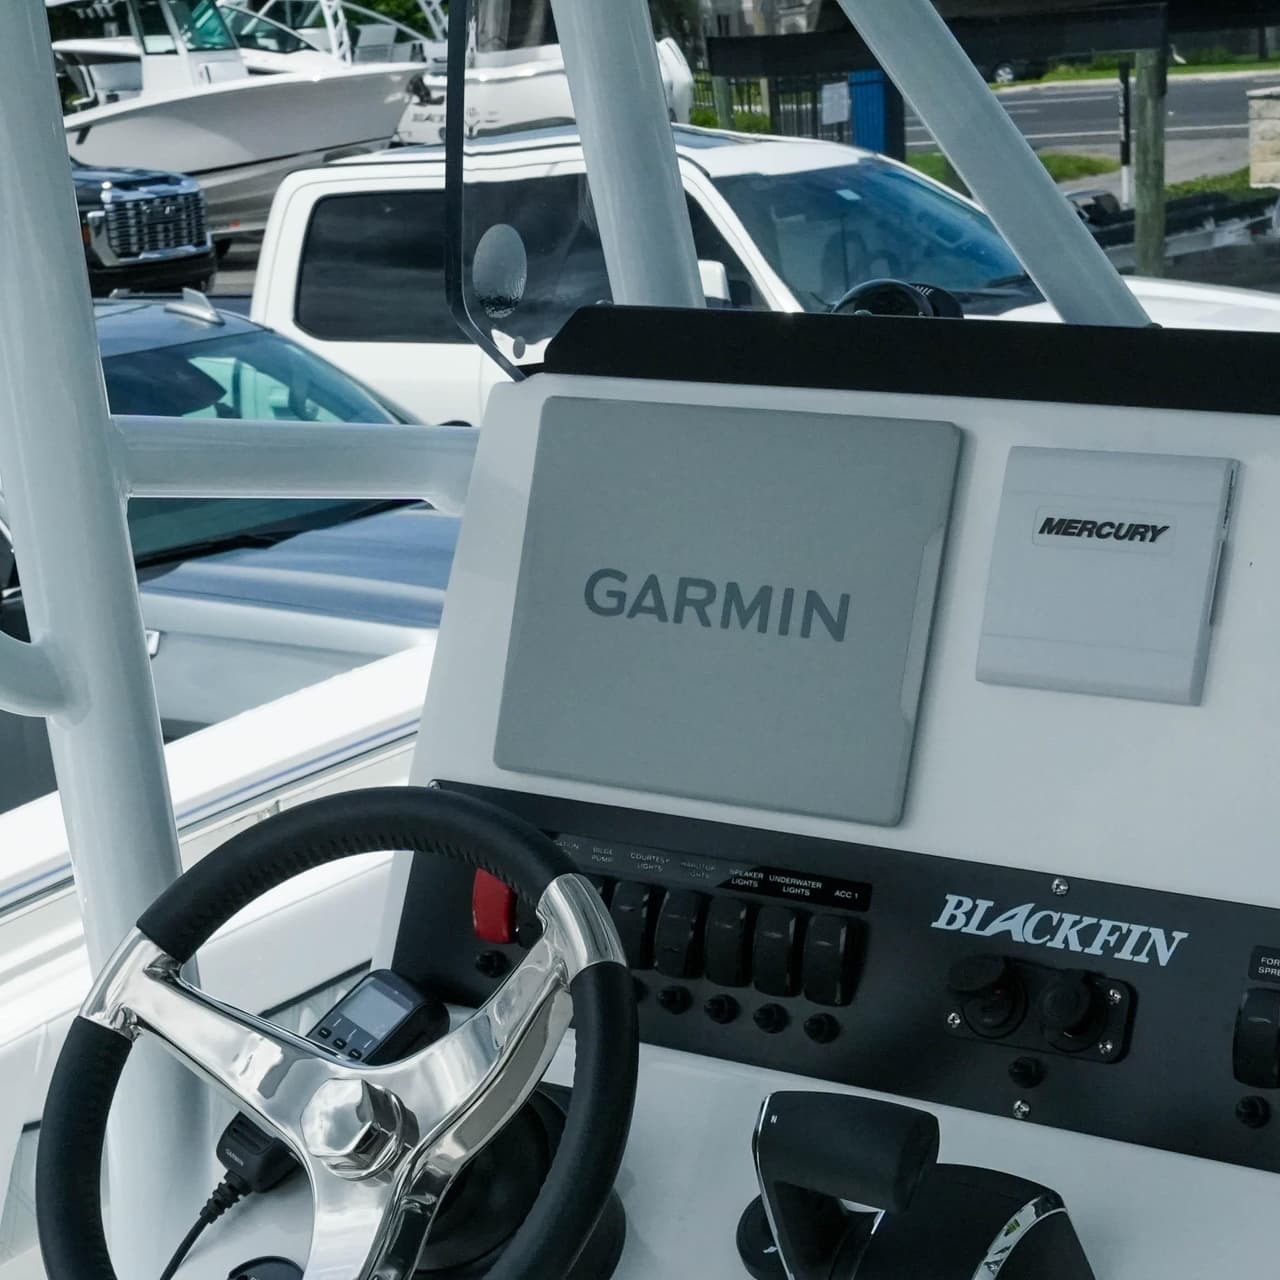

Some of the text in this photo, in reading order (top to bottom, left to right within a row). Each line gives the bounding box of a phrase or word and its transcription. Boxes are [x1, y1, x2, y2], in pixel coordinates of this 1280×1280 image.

[1038, 517, 1170, 543] MERCURY
[584, 567, 851, 642] GARMIN
[728, 868, 764, 880] SPEAKER
[731, 878, 759, 888] LIGHTS
[769, 874, 823, 889] UNDERWATER
[782, 886, 811, 897] LIGHTS
[834, 889, 852, 899] ACC
[931, 893, 1190, 967] BLACKFIN
